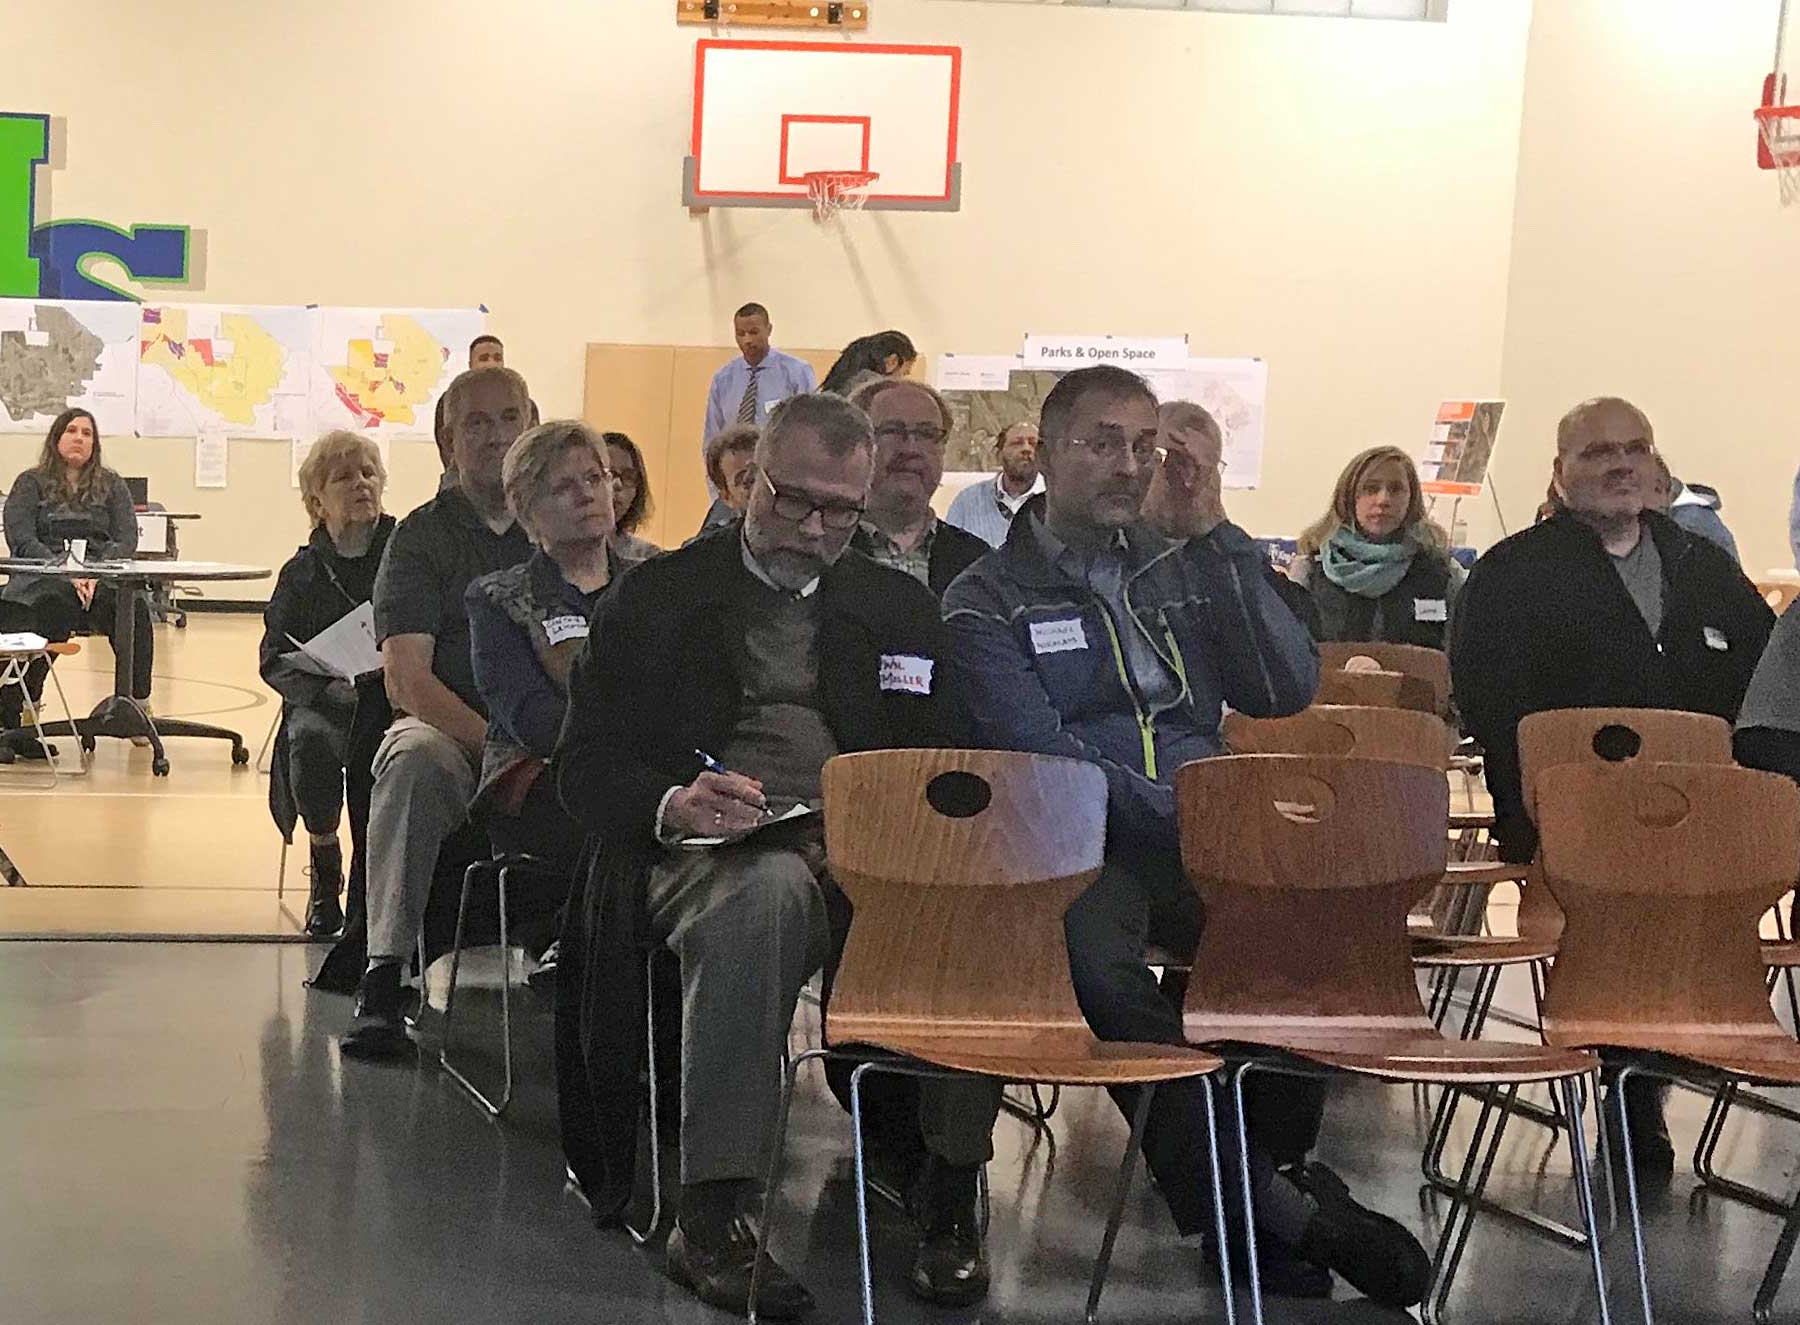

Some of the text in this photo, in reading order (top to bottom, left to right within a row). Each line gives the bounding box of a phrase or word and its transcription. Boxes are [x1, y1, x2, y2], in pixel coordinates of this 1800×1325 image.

[1041, 346, 1156, 360] Parks & Open Space
